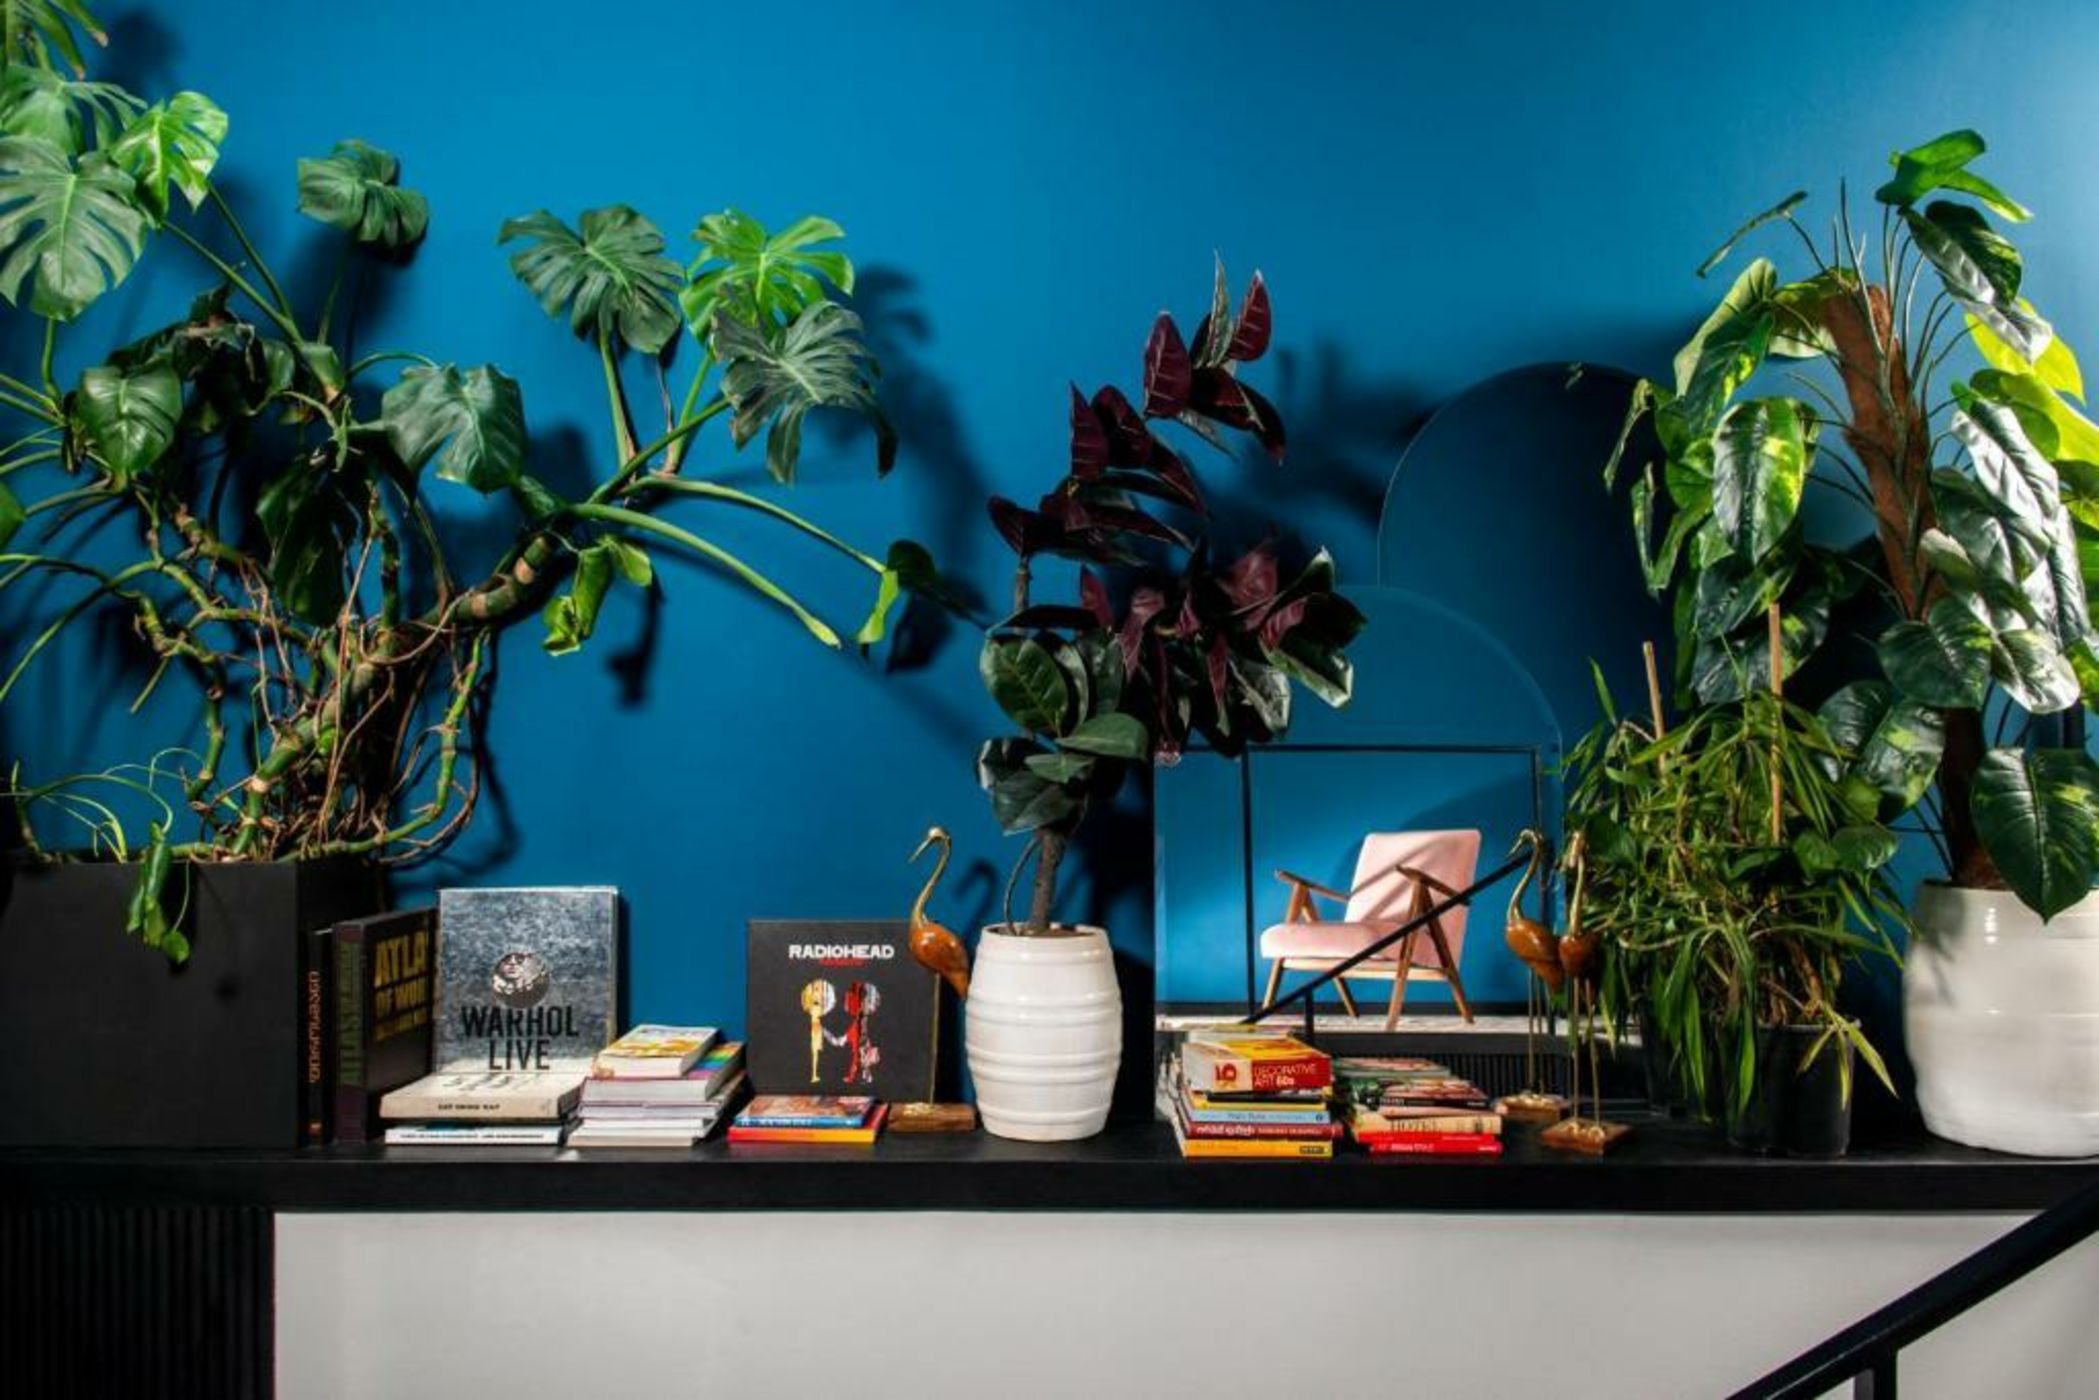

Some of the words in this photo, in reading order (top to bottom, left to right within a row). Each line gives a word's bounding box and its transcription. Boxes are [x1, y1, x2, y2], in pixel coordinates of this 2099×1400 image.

[374, 930, 428, 989] ATLA
[788, 944, 895, 959] RADIOHEAD
[461, 1006, 579, 1037] WARHOL
[489, 1040, 550, 1070] LIVE
[1254, 1063, 1317, 1077] DECORATIVE
[1254, 1076, 1274, 1087] ART
